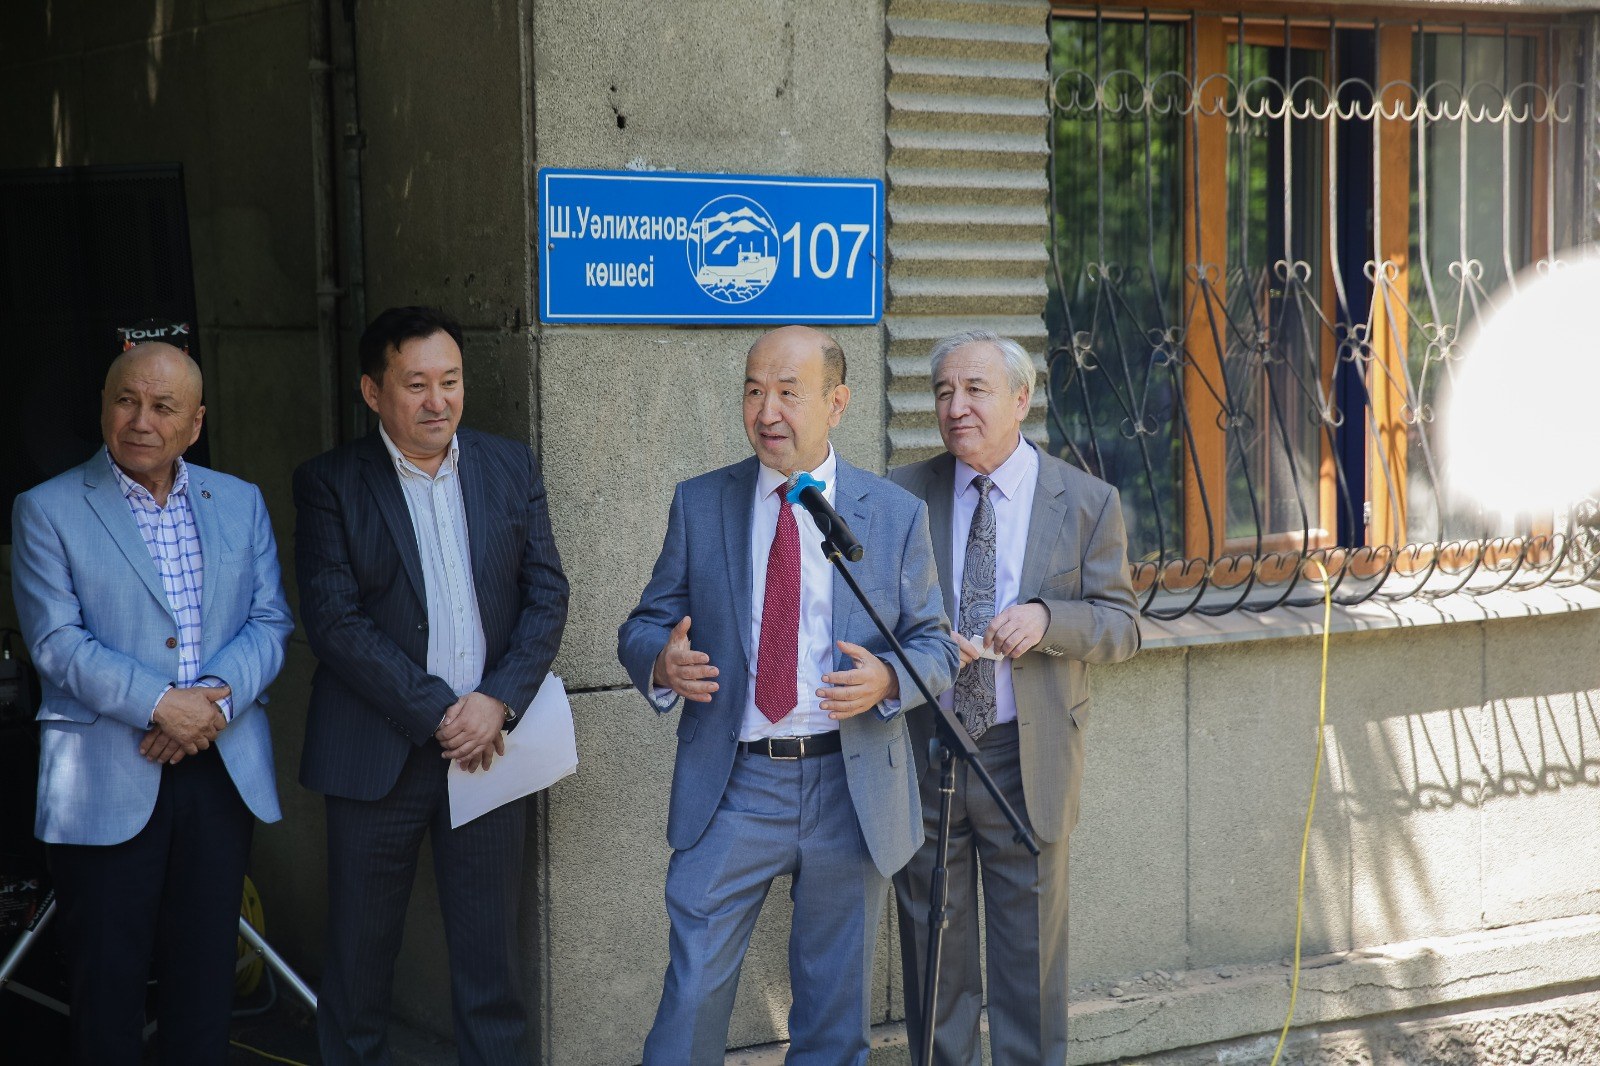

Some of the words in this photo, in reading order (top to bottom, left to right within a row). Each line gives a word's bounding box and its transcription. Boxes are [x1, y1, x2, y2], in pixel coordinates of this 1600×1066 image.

[550, 205, 688, 241] Ш.Уәлиханов
[782, 221, 870, 280] 107
[585, 255, 655, 288] көшесі
[118, 327, 168, 340] Tour
[171, 323, 189, 336] X
